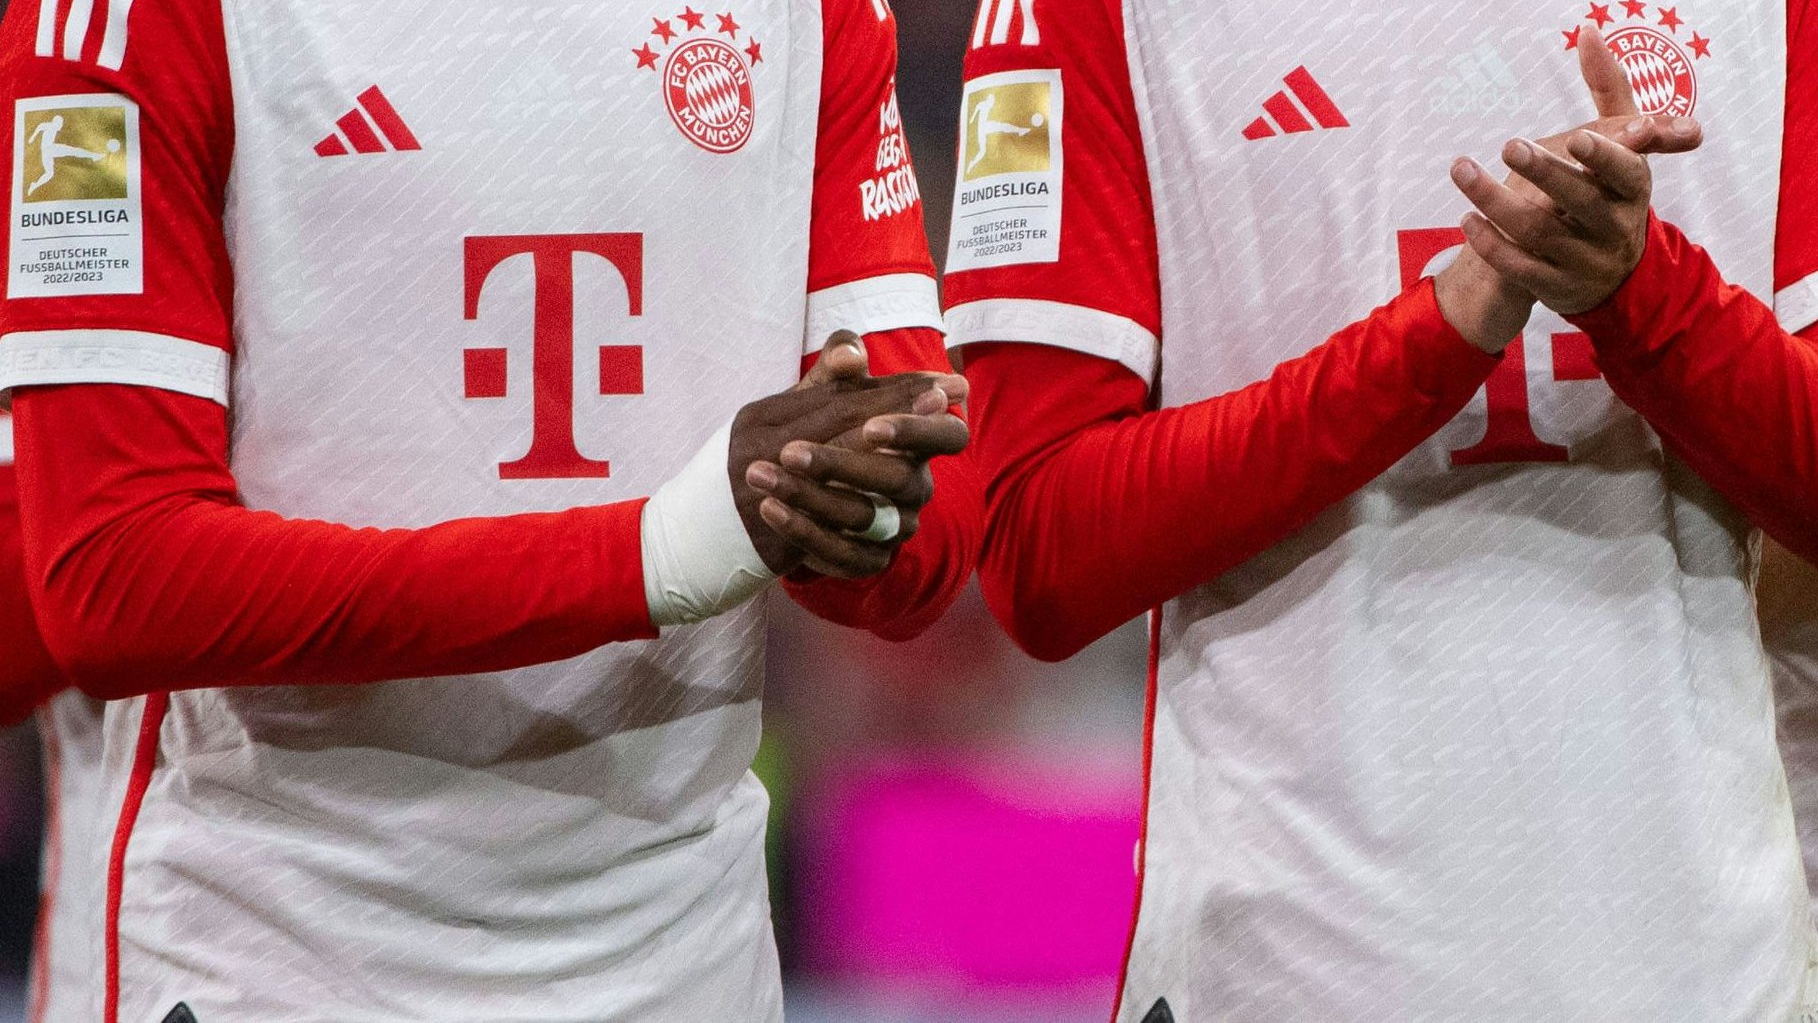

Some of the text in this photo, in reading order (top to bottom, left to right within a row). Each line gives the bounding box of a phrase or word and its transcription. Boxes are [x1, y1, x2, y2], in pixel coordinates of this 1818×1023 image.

[1617, 34, 1687, 76] BAYERN
[671, 45, 747, 88] FC BAYERN
[961, 182, 1049, 205] BUNDESLIGA
[21, 209, 129, 228] BUNDESLIGA
[973, 219, 1027, 236] DEUTSCHER
[957, 229, 1047, 249] FUSSBALLMEISTER
[39, 248, 107, 261] DEUTSCHER
[974, 242, 1022, 257] 2022/2023
[20, 259, 130, 273] FUSSBALLMEISTER
[43, 271, 104, 284] 2022/2023
[464, 232, 644, 479] T
